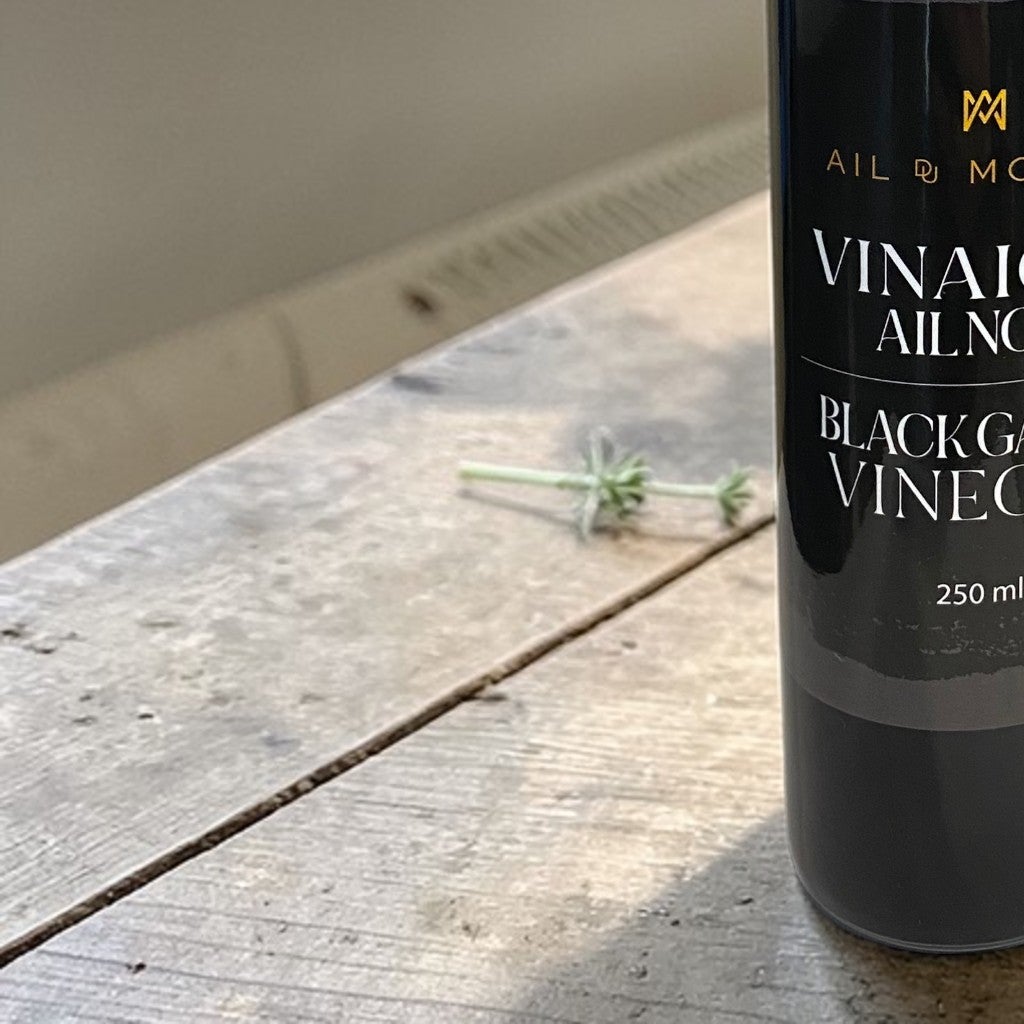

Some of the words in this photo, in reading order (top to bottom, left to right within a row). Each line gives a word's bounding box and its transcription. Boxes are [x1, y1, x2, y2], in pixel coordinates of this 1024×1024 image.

[826, 148, 890, 181] AIL
[876, 308, 959, 357] AIL
[819, 393, 969, 459] BLACK
[936, 582, 985, 605] 250
[992, 576, 1024, 603] ml
